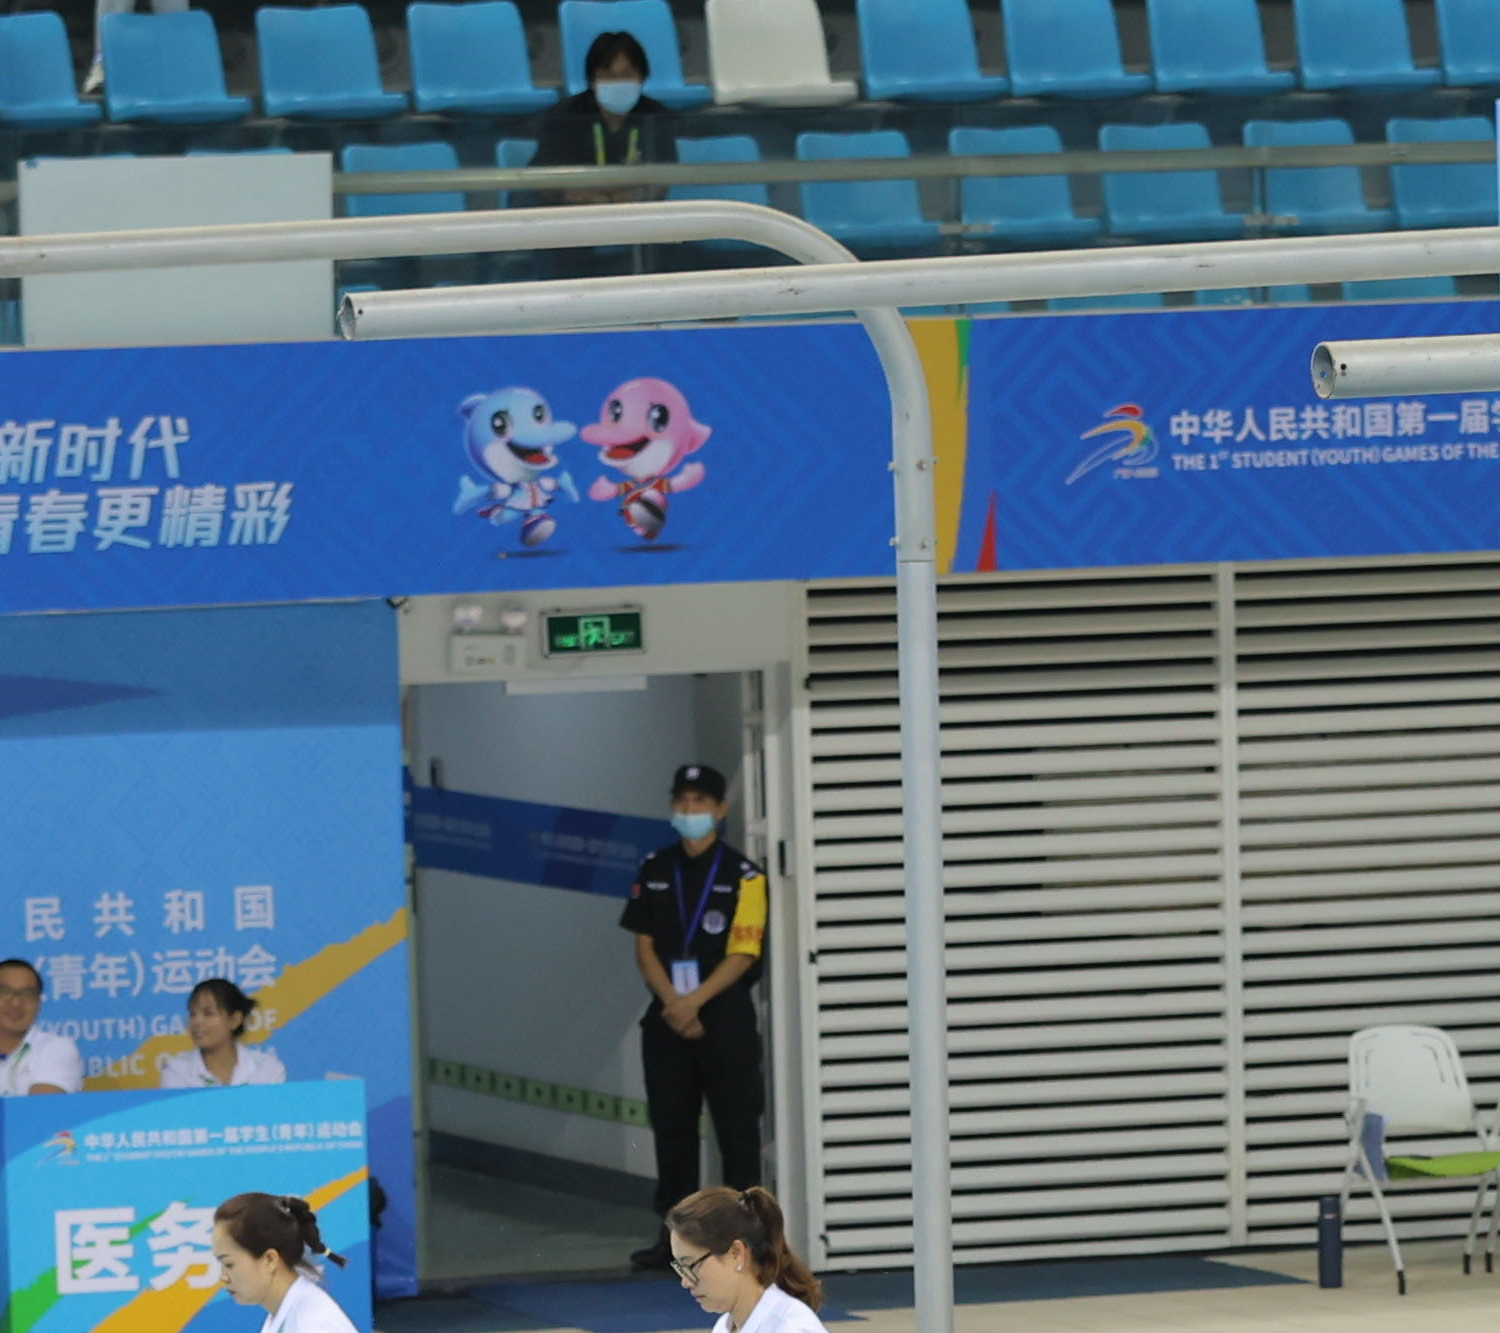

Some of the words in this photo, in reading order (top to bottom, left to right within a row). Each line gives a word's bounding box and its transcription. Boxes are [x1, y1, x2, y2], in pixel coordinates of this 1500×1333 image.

[1172, 453, 1205, 472] THE
[1231, 449, 1309, 470] STUDENT
[1311, 445, 1382, 468] (YOUTH)
[1382, 443, 1438, 465] GAMES
[1441, 443, 1463, 463] OF
[1466, 440, 1499, 461] THE
[55, 1201, 228, 1295] 医务
